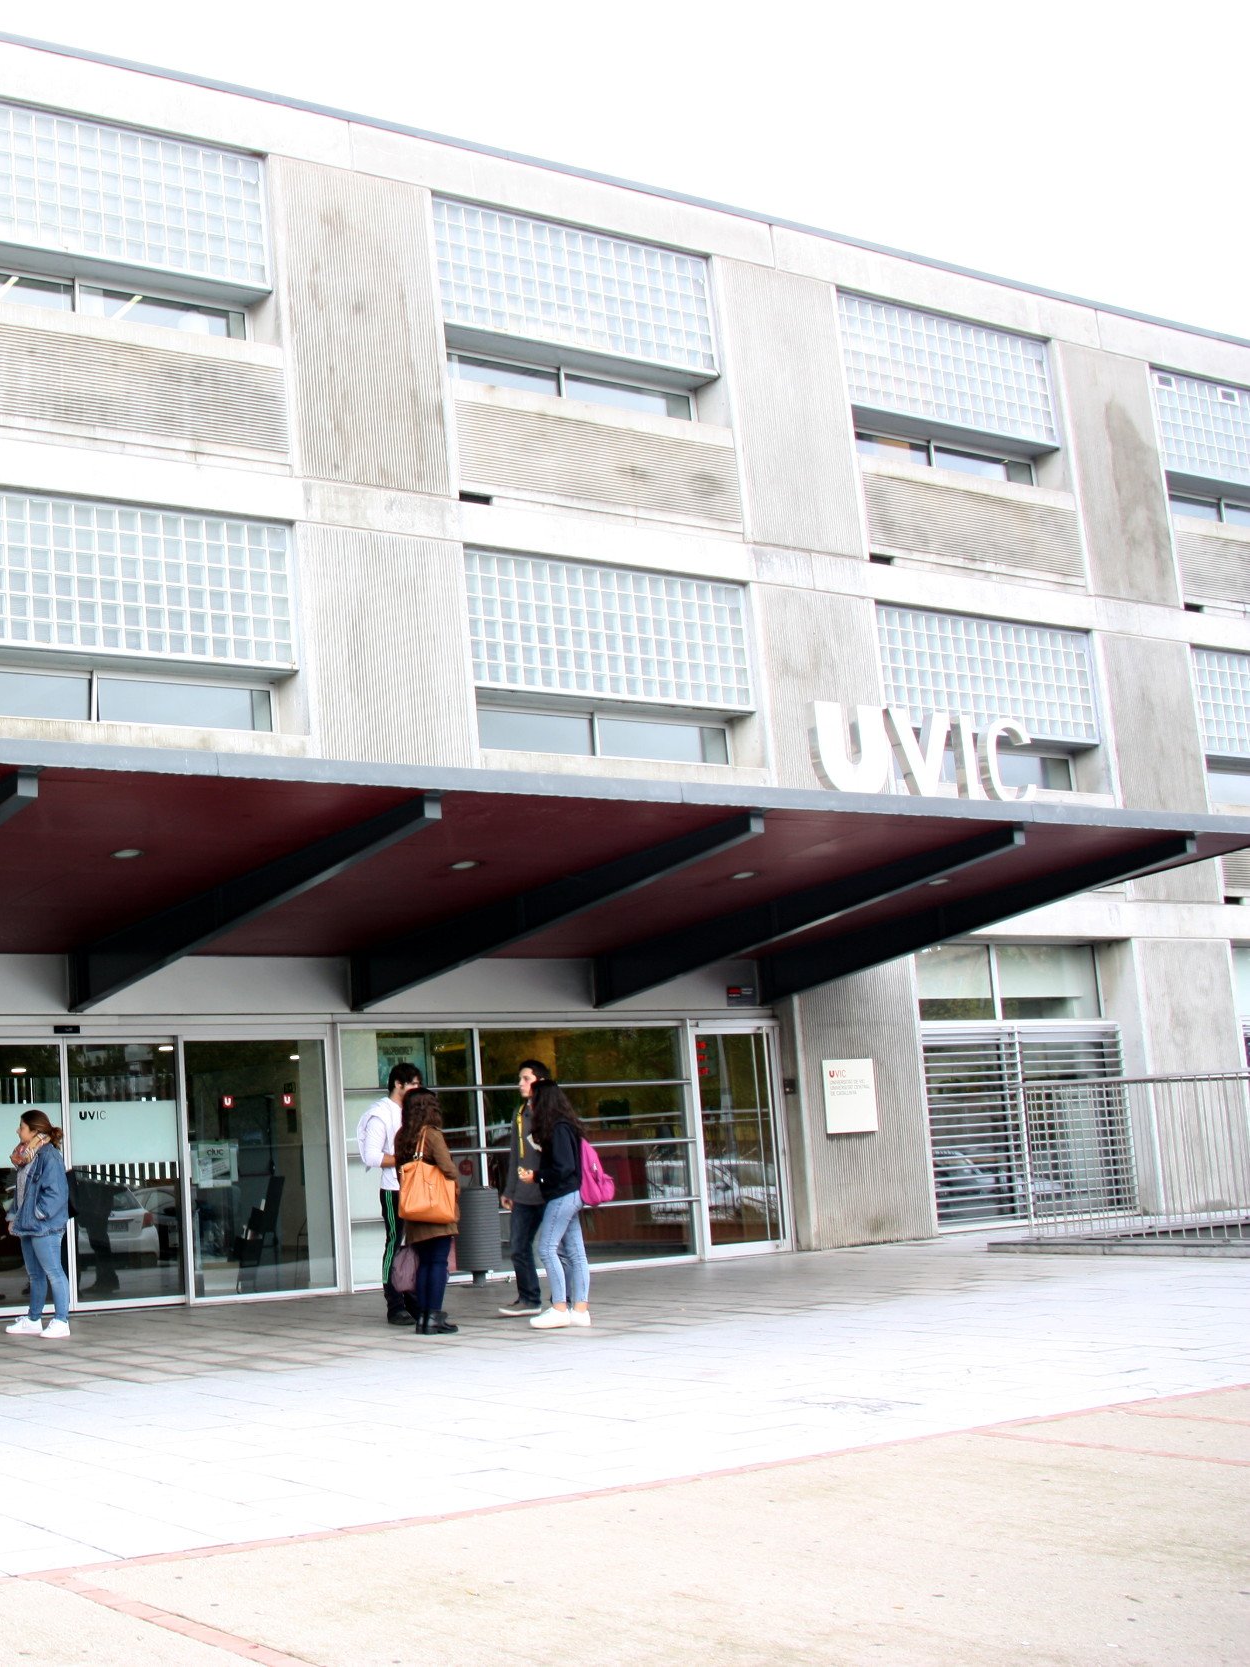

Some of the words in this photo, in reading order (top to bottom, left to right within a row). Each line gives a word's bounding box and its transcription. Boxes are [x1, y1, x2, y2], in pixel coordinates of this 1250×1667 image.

[808, 700, 1038, 801] UVIC
[829, 1070, 846, 1078] UVIC
[78, 1110, 107, 1121] UVIC
